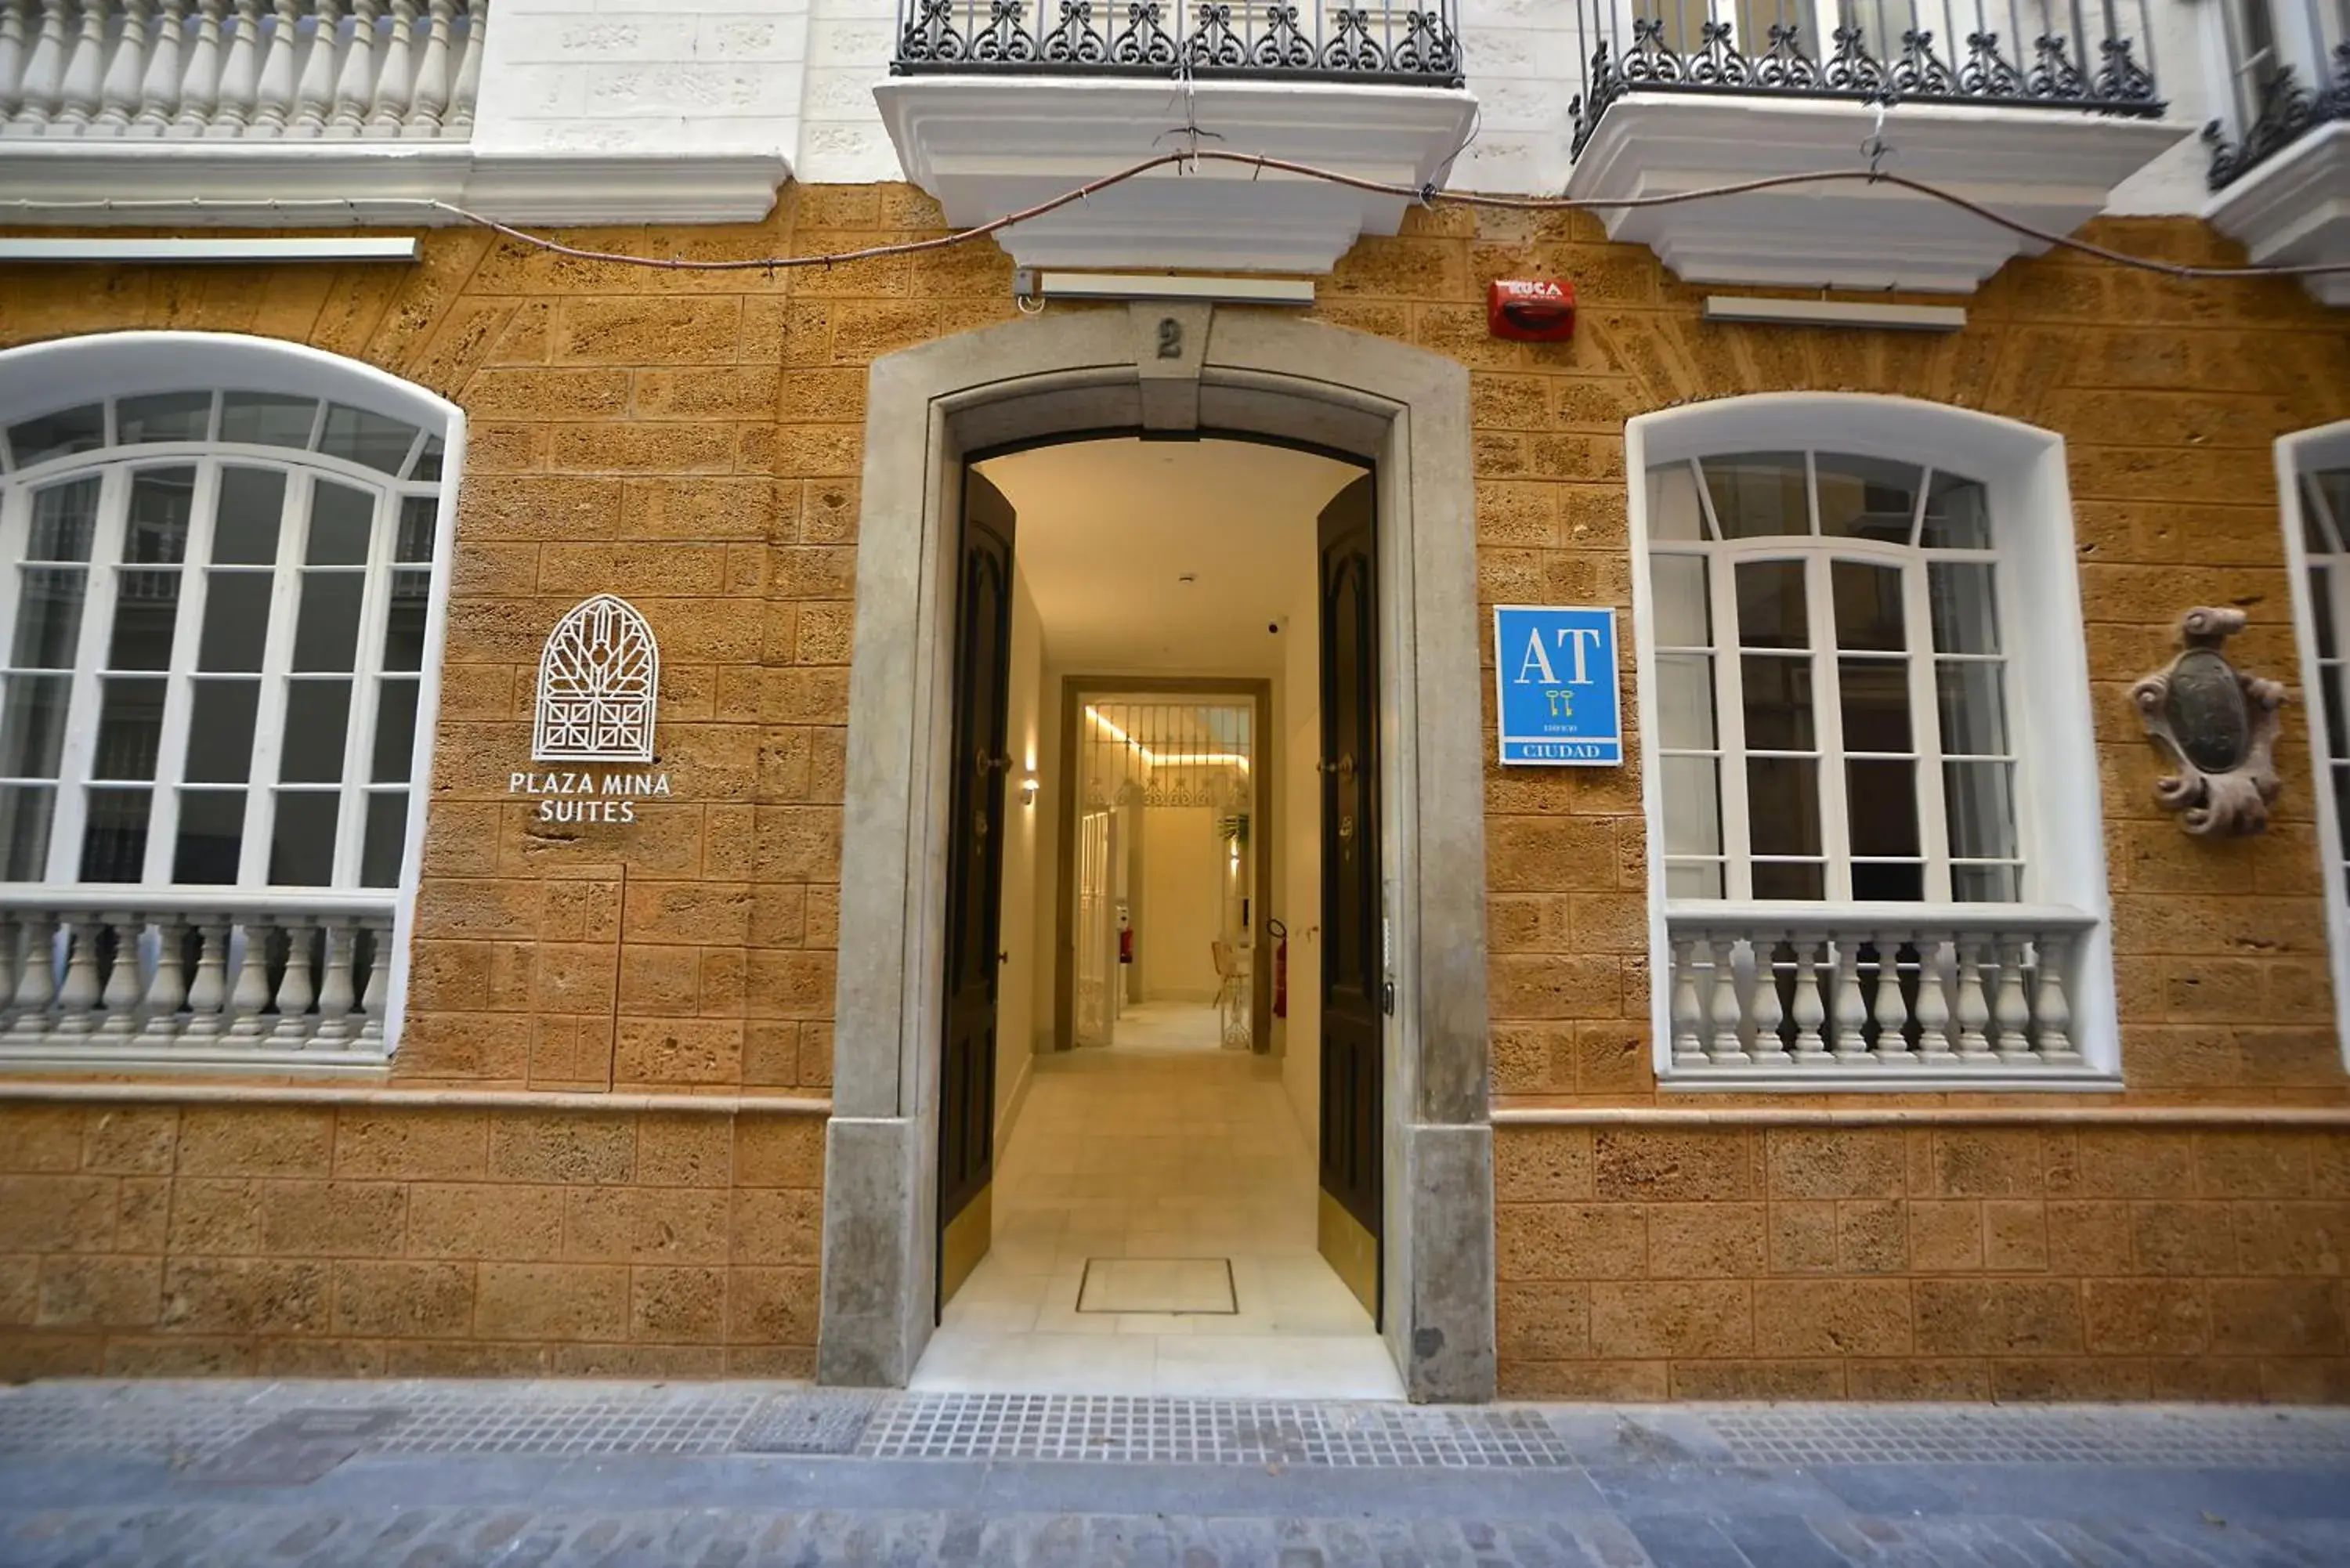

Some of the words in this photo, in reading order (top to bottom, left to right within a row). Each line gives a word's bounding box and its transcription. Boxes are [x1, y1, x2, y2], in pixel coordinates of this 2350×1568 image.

[1156, 317, 1182, 359] 2
[1514, 627, 1601, 685] AT
[1522, 742, 1600, 758] CIUDAD
[510, 772, 594, 794] PLAZA
[601, 773, 671, 796] MINA
[540, 800, 634, 822] SUITES
